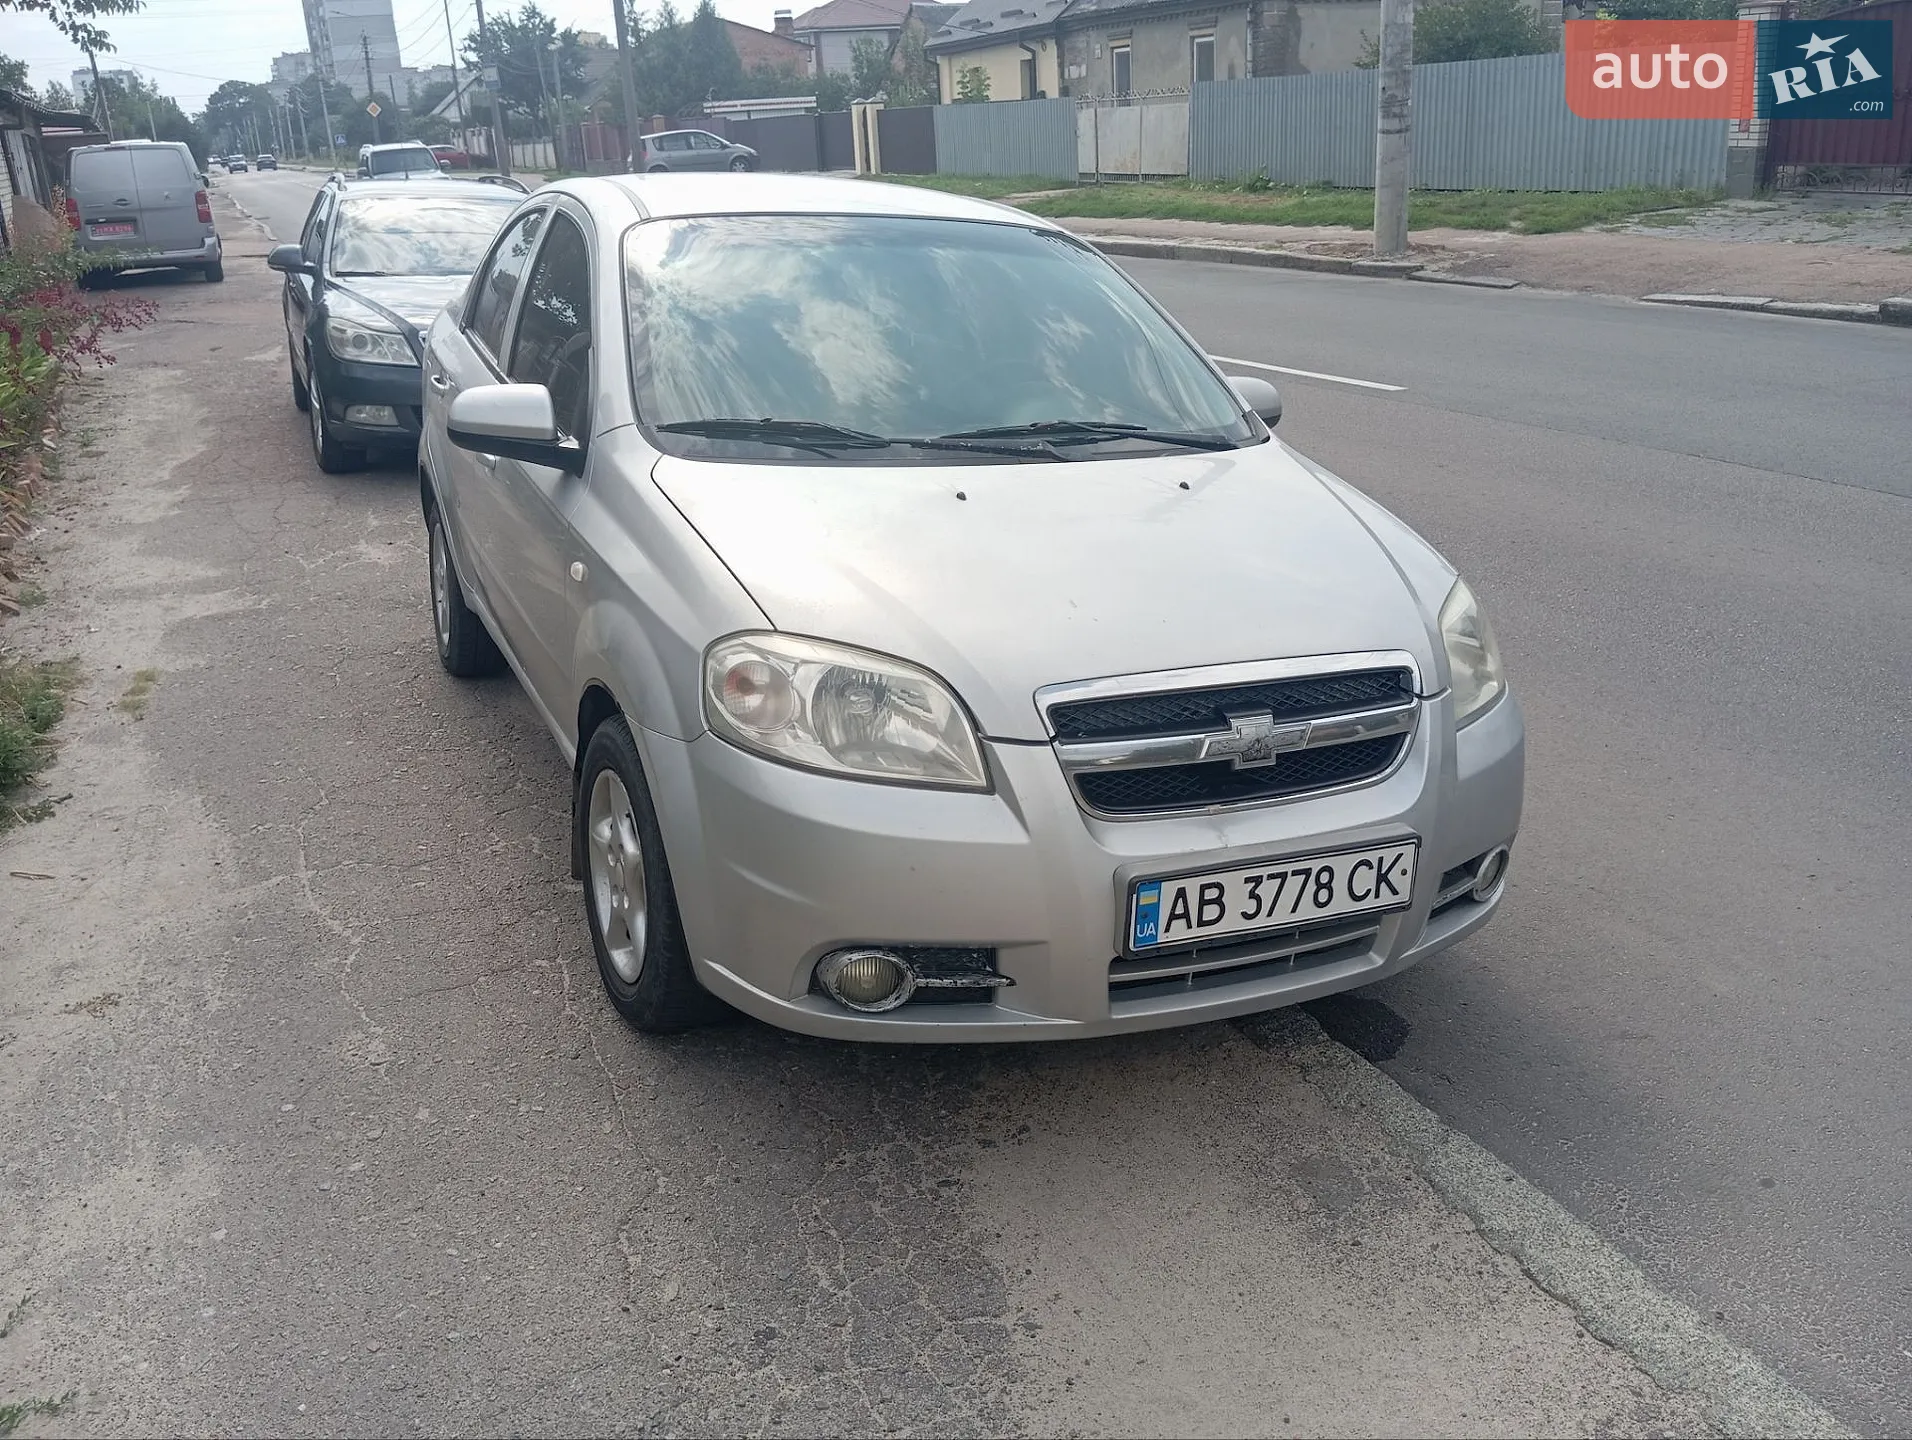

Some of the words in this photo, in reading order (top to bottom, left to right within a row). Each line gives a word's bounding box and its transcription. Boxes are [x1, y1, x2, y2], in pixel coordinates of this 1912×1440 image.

[1163, 882, 1226, 933] AB
[1240, 865, 1335, 921] 3778
[1347, 852, 1404, 902] CK
[1136, 920, 1157, 938] UA
